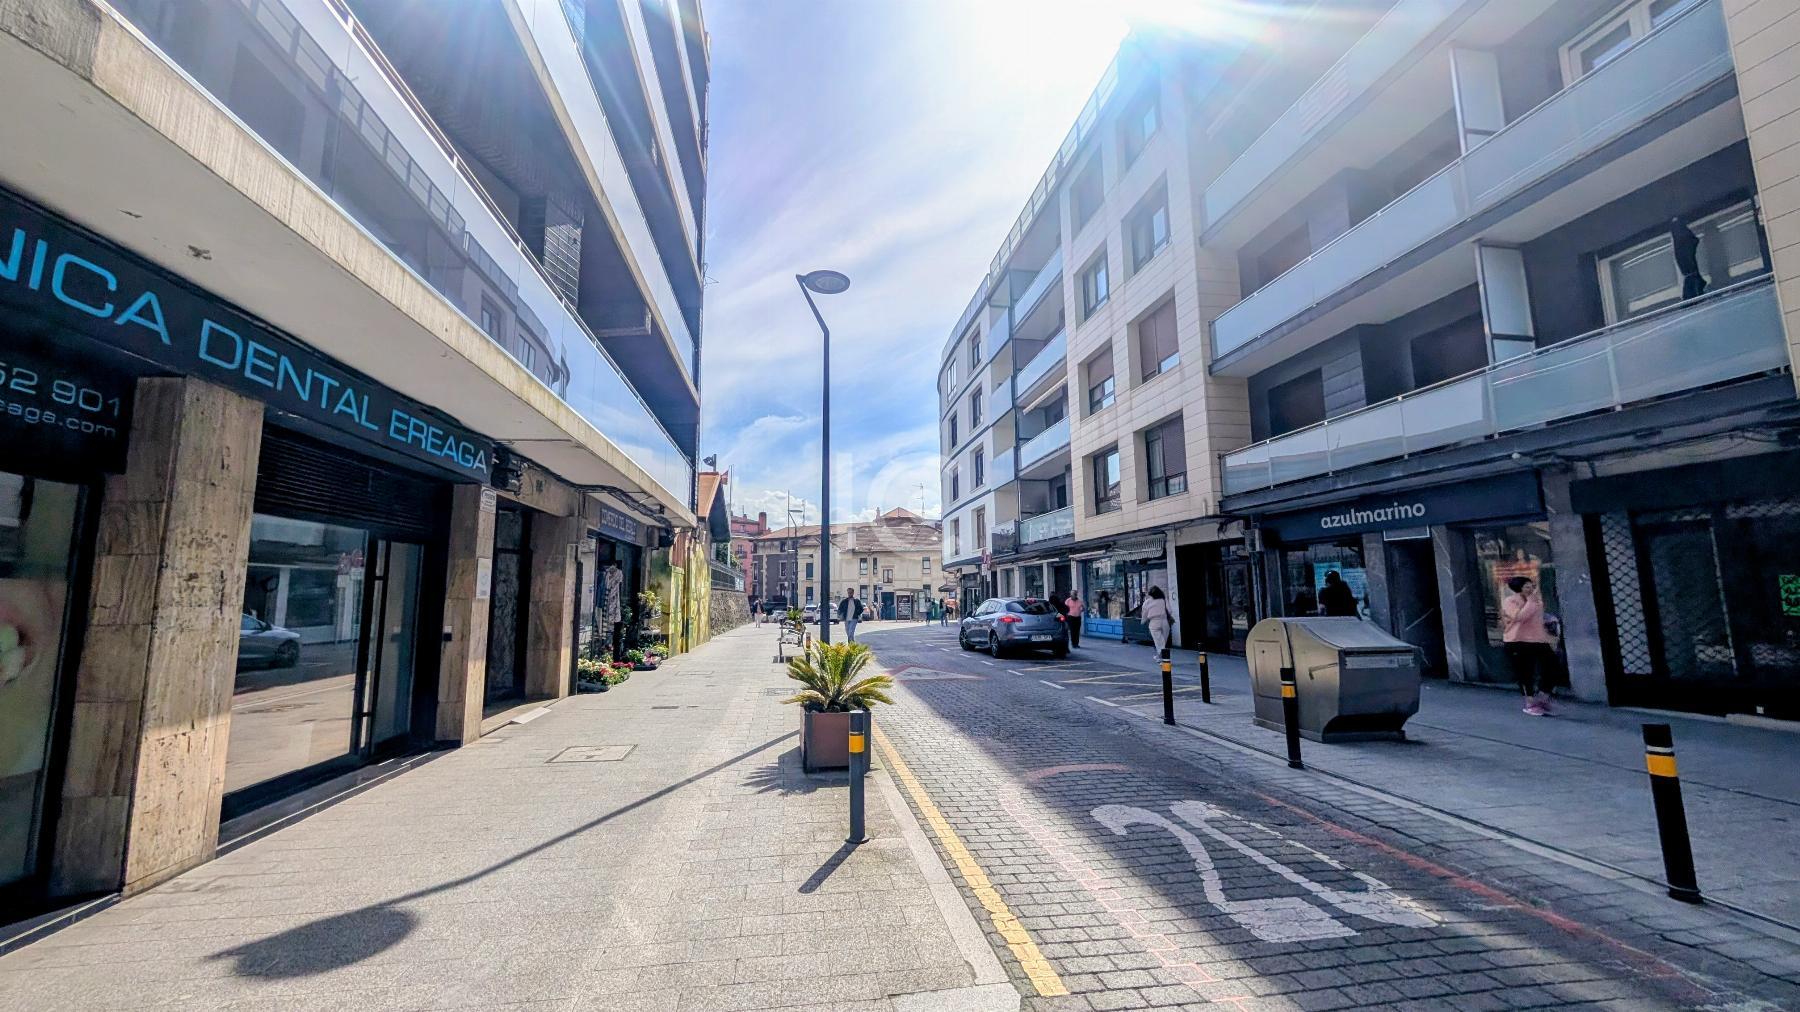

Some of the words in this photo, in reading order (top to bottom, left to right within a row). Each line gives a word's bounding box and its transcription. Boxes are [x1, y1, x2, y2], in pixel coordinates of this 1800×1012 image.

[0, 361, 38, 395] 2
[52, 379, 120, 417] 901
[199, 318, 379, 431] DENTAL
[389, 408, 487, 474] EREAGA
[1321, 502, 1426, 529] azulmarino
